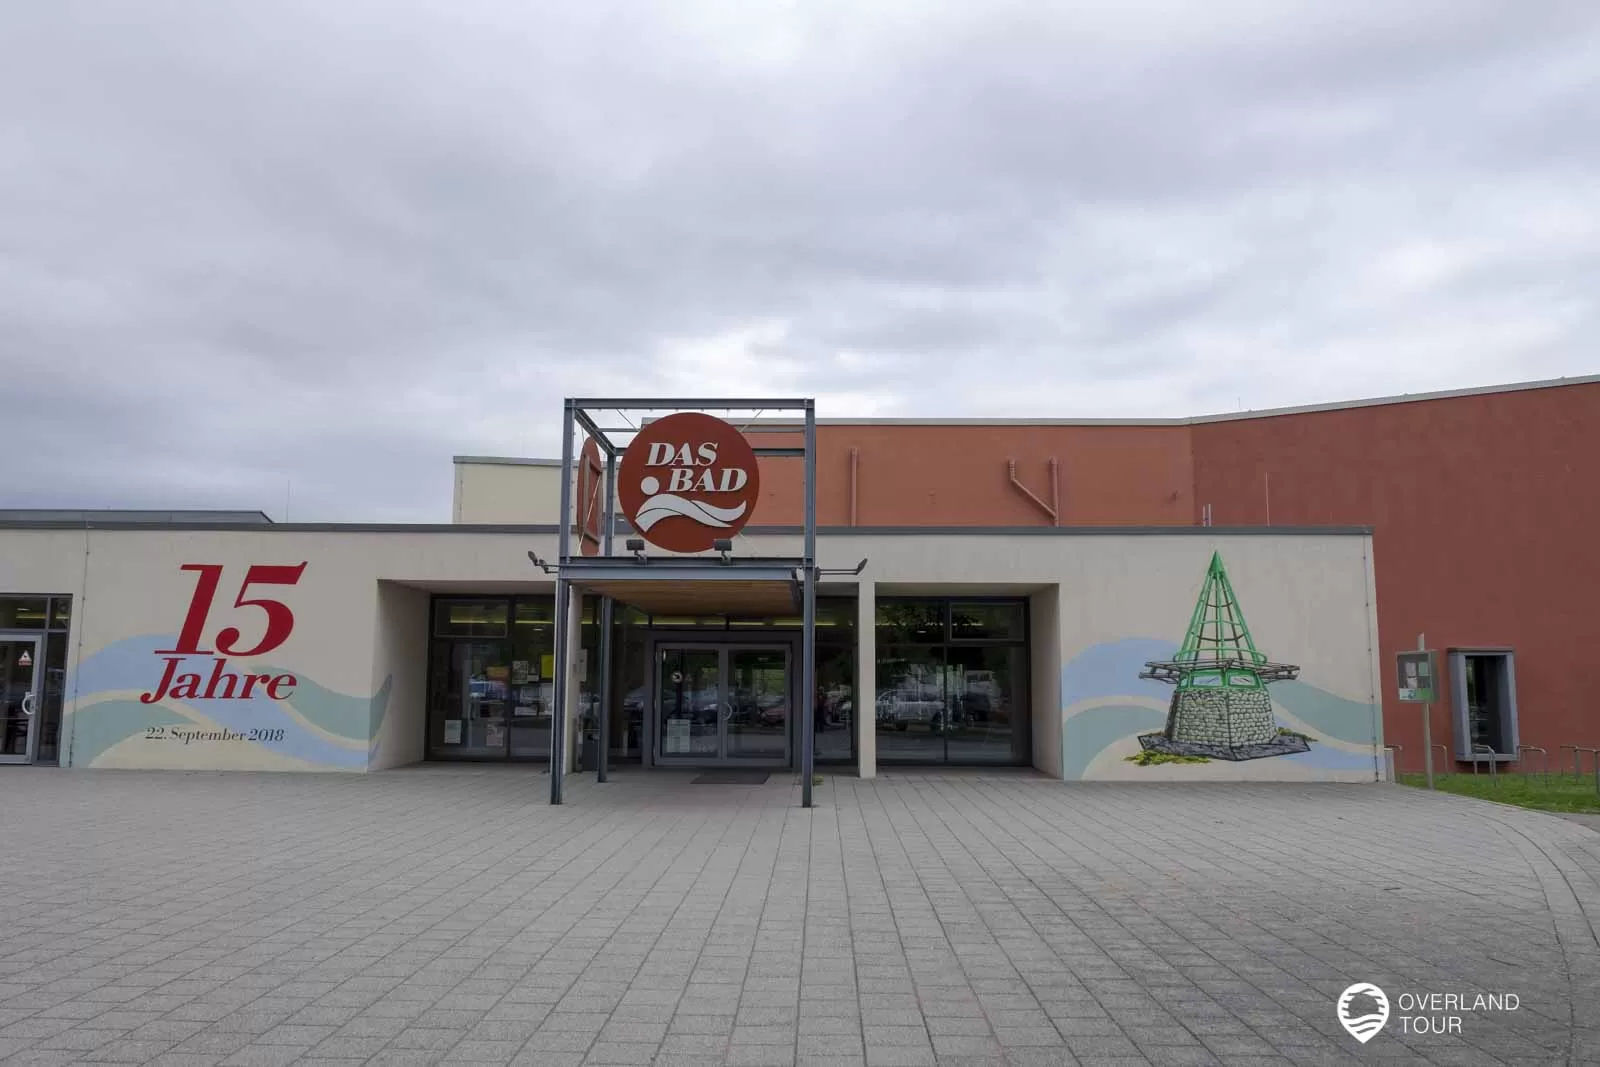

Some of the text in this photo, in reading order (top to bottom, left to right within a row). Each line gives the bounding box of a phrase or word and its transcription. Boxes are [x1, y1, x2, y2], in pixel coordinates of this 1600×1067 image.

[645, 442, 718, 466] DAS
[666, 468, 748, 492] BAD
[154, 561, 308, 656] 15
[140, 657, 297, 704] Jahre
[145, 727, 284, 744] 22. September 2018
